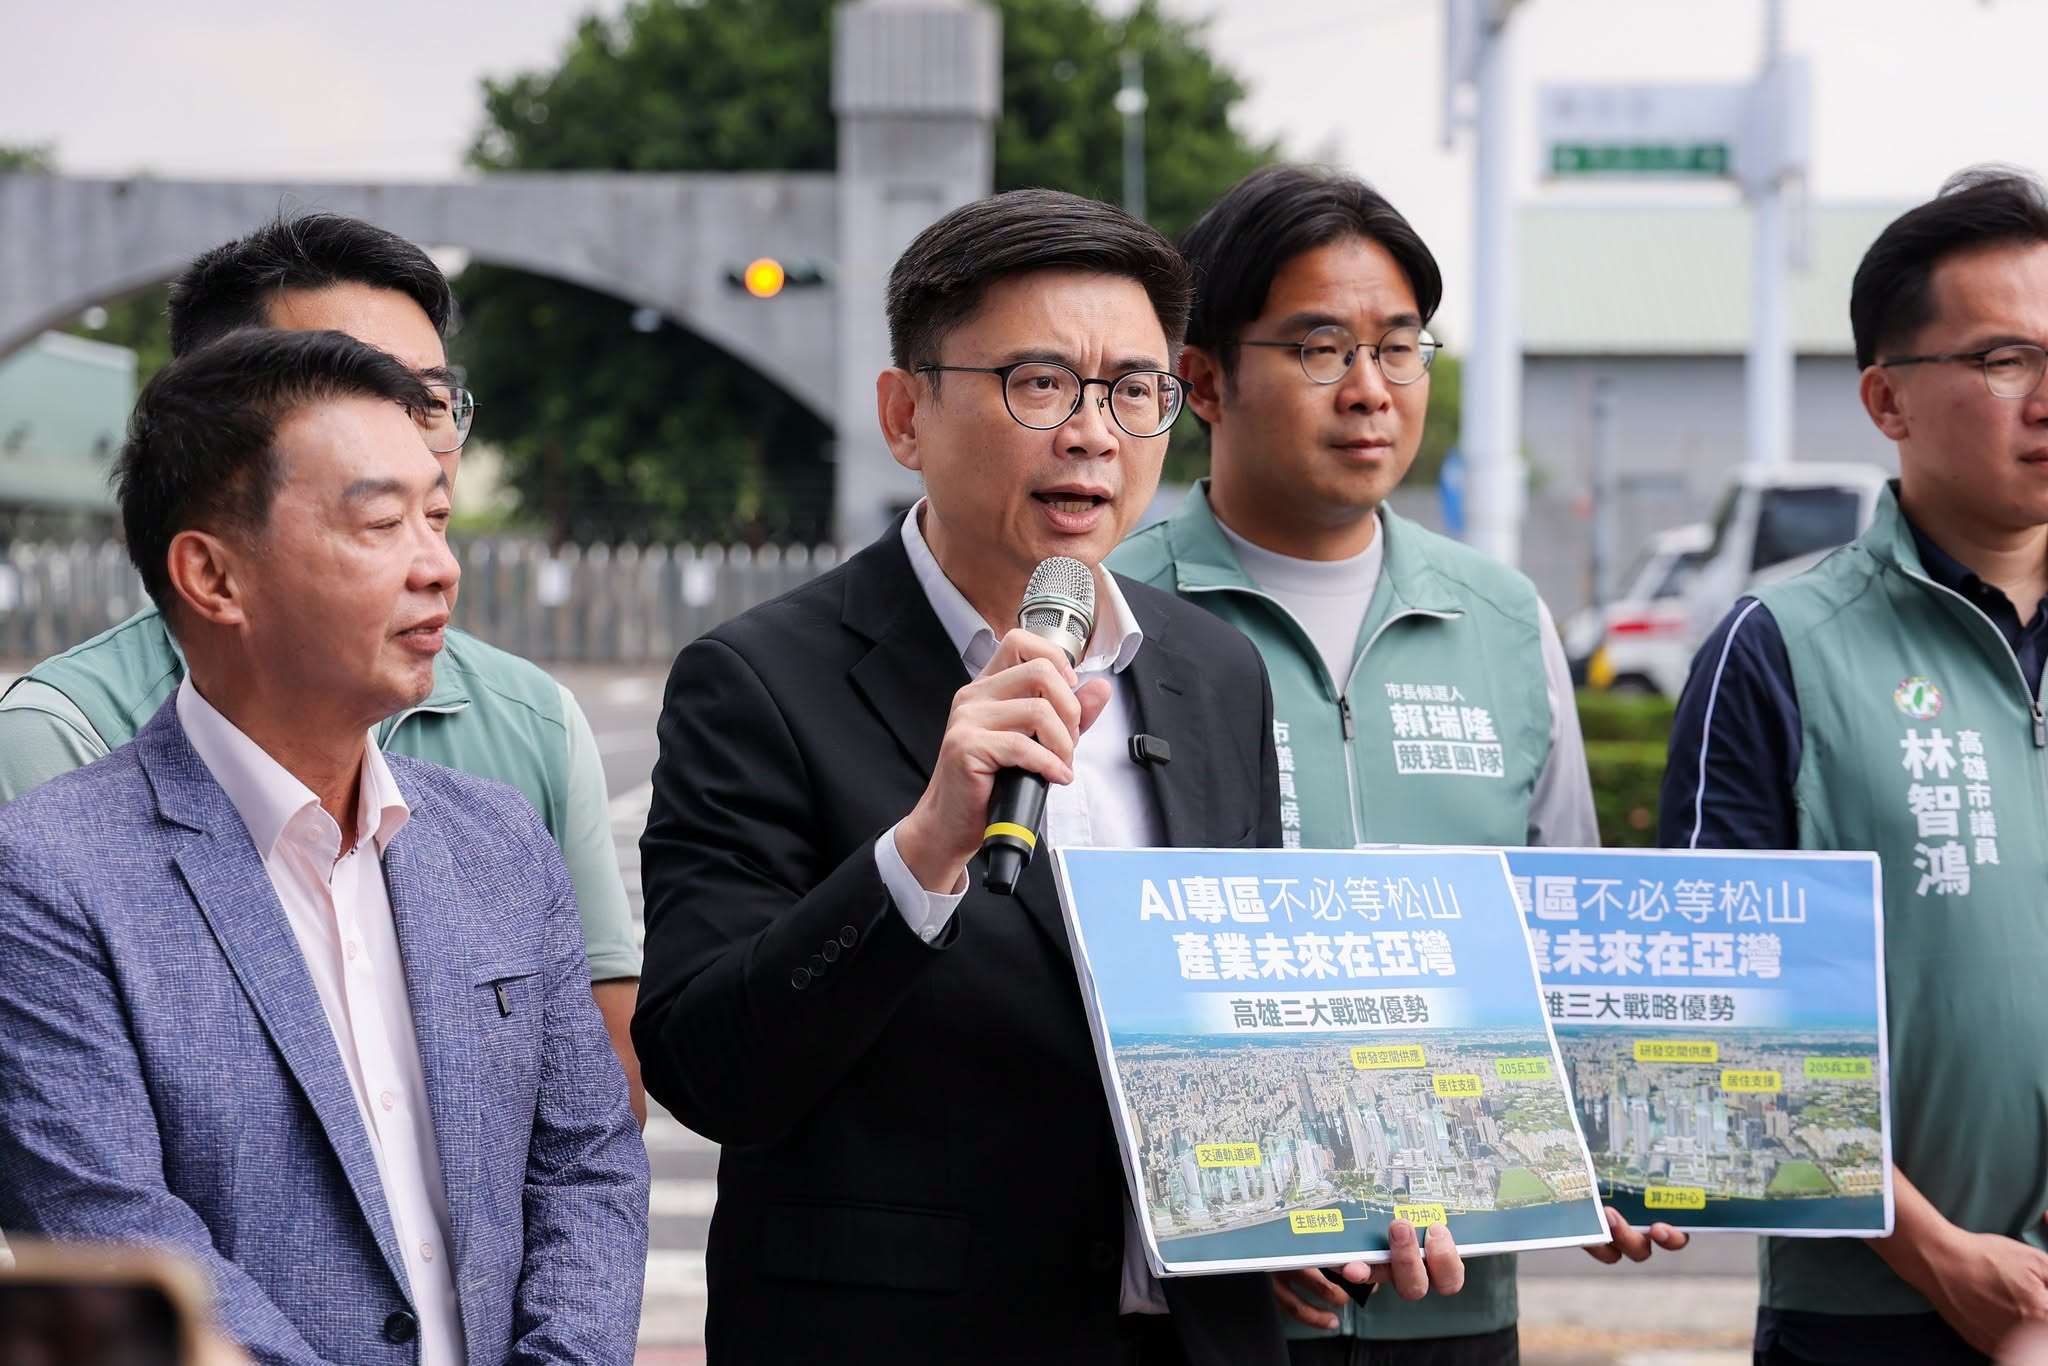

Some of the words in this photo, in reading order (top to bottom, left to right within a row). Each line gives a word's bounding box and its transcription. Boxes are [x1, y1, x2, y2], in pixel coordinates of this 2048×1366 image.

[1385, 683, 1465, 701] 市長候選人
[1389, 703, 1498, 741] 賴瑞隆
[1399, 743, 1503, 773] 競選團隊
[1956, 729, 2000, 865] 高雄市議員
[1900, 728, 1971, 896] 林智鴻
[1140, 876, 1462, 924] AI專區不必等松山
[1172, 930, 1457, 981] 產業未來在亞灣
[1230, 995, 1430, 1029] 高雄三大戰略優勢
[1356, 1049, 1421, 1065] 研發空間供應
[1438, 1078, 1478, 1093] 居住支援
[1727, 1074, 1776, 1088] 居住支援
[1201, 1147, 1257, 1162] 交通軌道網
[1651, 1191, 1701, 1205] 算力中心
[1295, 1214, 1339, 1229] 生態休憩
